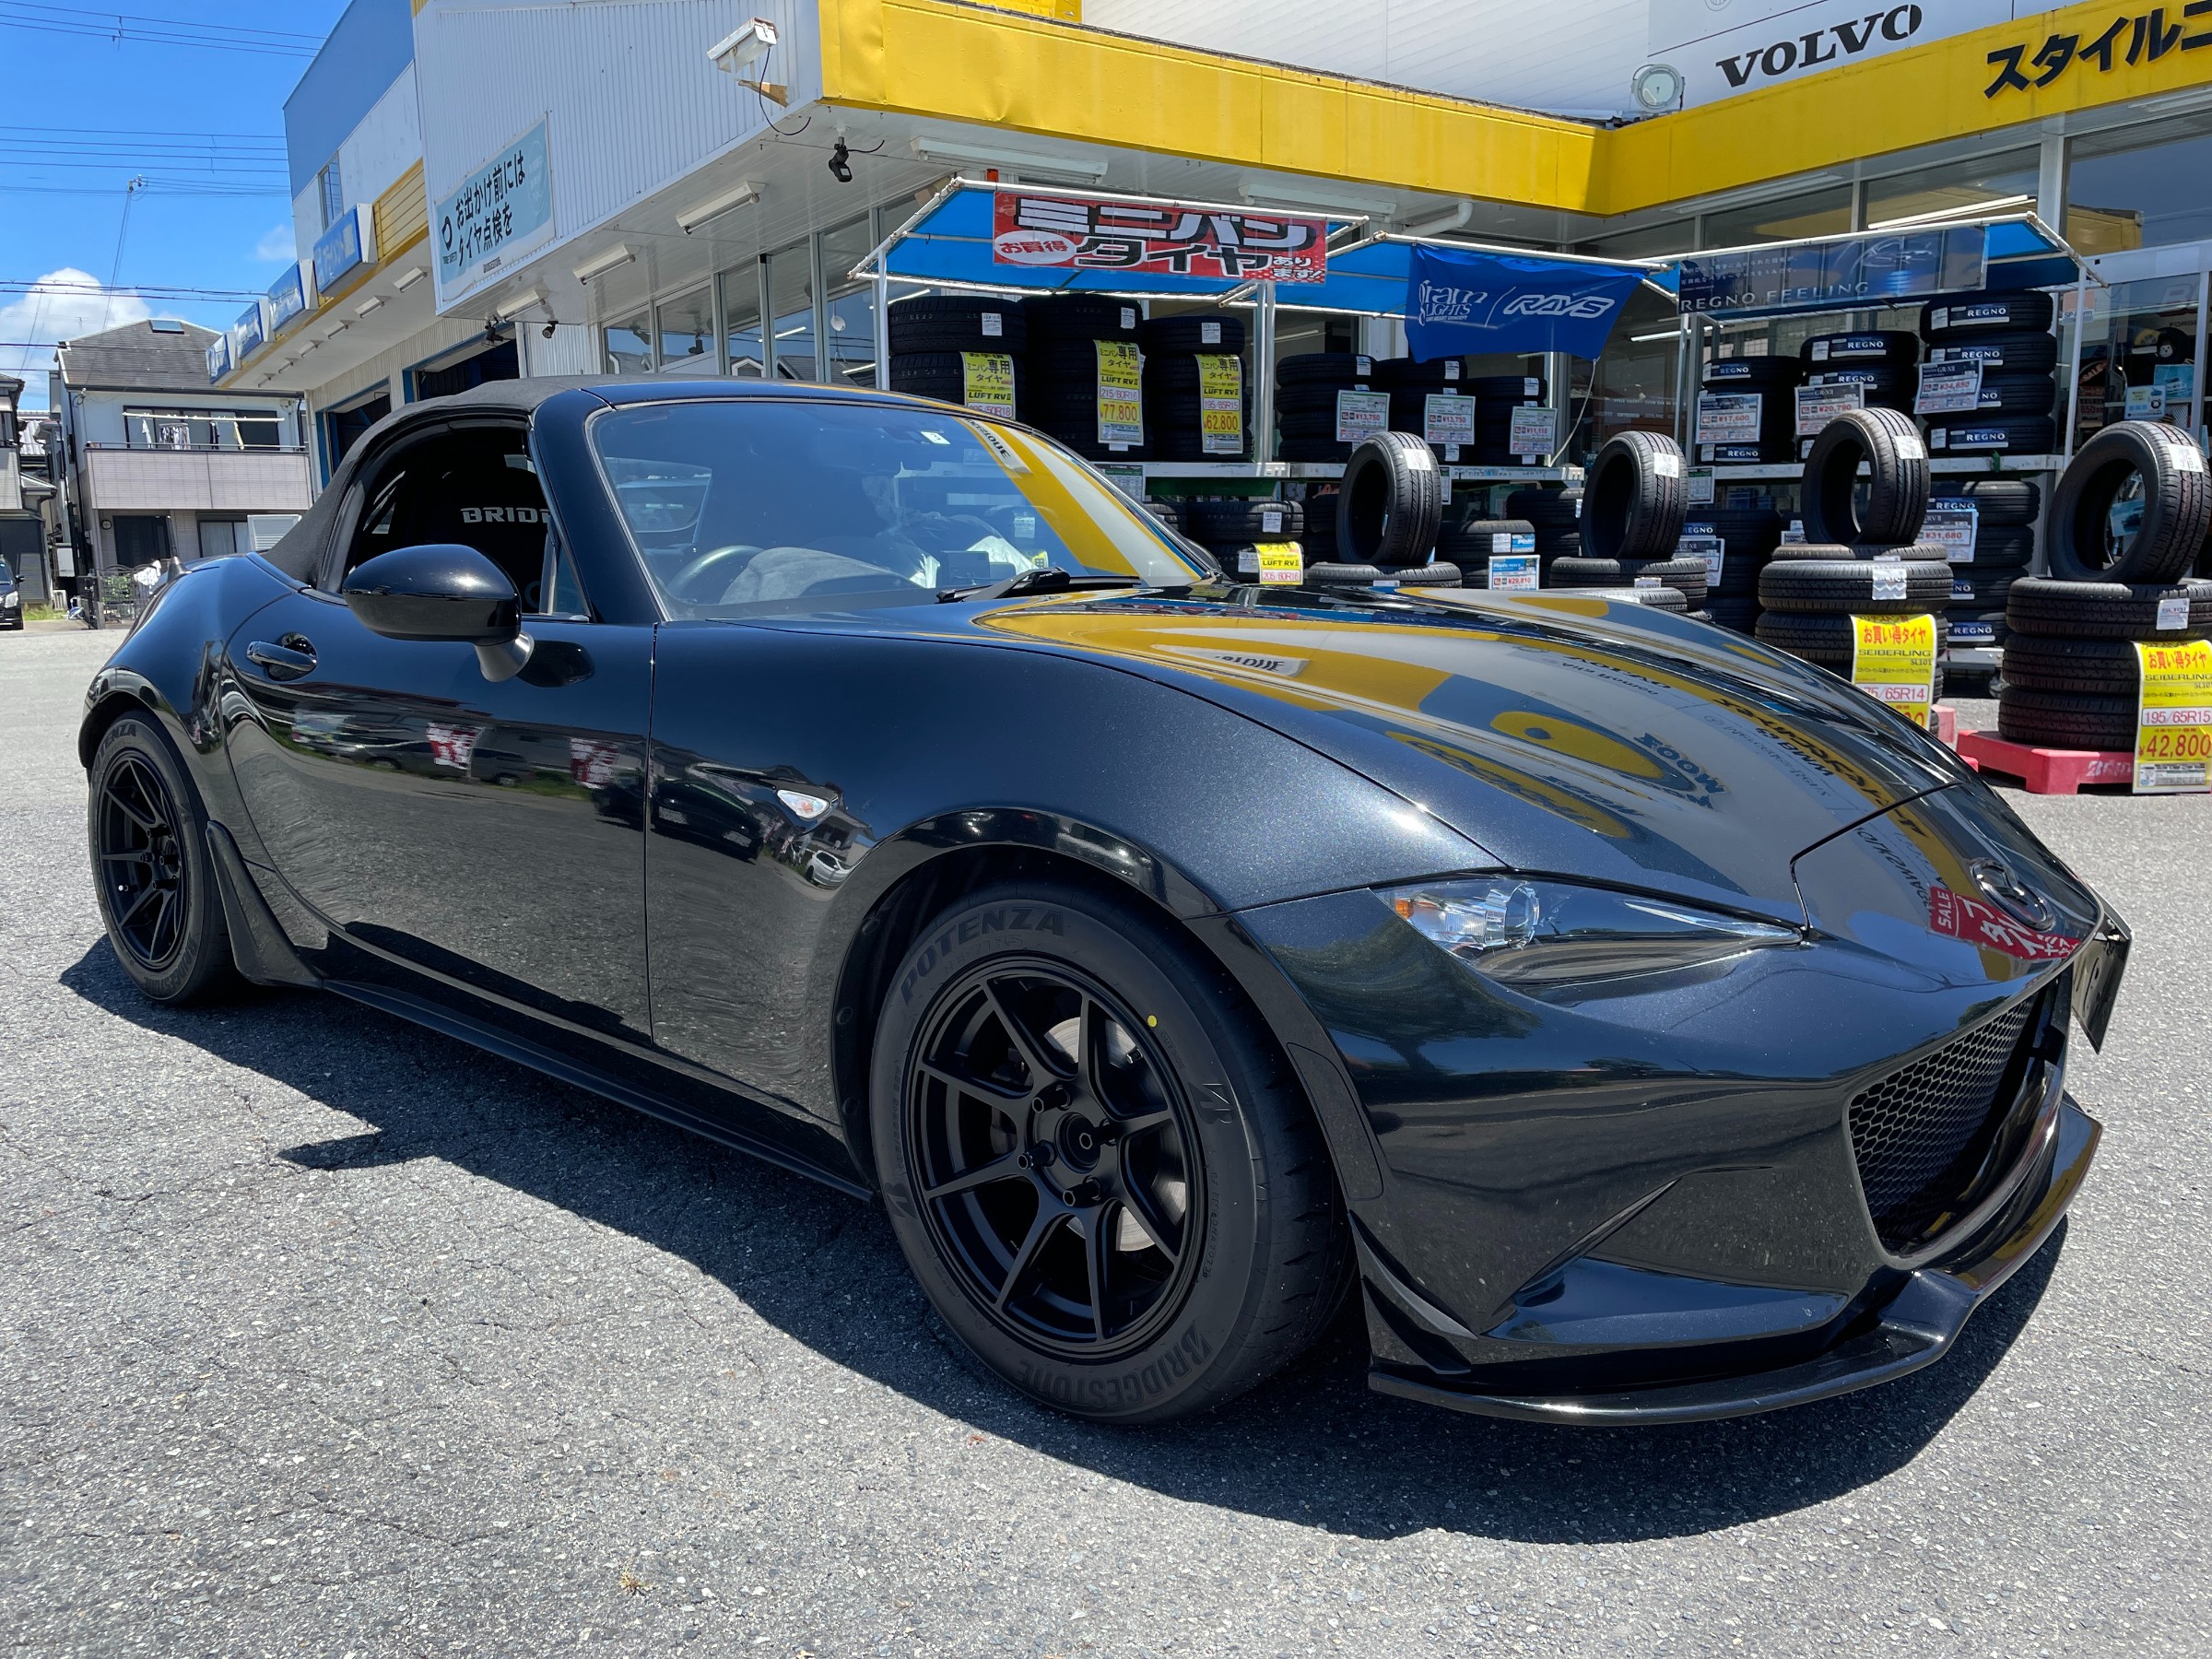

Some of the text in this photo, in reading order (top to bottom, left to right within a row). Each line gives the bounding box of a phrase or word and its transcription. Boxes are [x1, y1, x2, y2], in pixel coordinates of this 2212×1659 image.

[1715, 4, 1923, 88] VOLVO
[456, 150, 525, 229] お出かけ前には
[1016, 196, 1312, 250] ミニバン
[459, 202, 512, 266] タイヤ点検を
[998, 239, 1069, 254] お買得
[1074, 235, 1273, 277] タイヤ
[1273, 255, 1312, 267] あり
[1680, 281, 1869, 312] REGNO FEELING
[1503, 294, 1616, 319] RAYS
[1967, 307, 2006, 317] REGNO
[1847, 340, 1884, 348] REGNO
[1961, 350, 2000, 359] REGNO
[1108, 359, 1131, 368] タイヤ
[976, 374, 1003, 382] タイヤ
[1209, 371, 1232, 380] タイヤ
[1838, 374, 1875, 382] REGNO
[1966, 432, 2006, 441] REGNO
[1936, 501, 1975, 510] REGNO
[1925, 532, 1962, 540] ¥31,680
[1864, 626, 1926, 644] お買い得タイヤ
[1954, 626, 1993, 634] REGNO
[2148, 651, 2206, 669] お買い得タイヤ
[1864, 687, 1925, 700] 75/65R14
[2145, 710, 2211, 724] 195/65R15
[2138, 733, 2211, 758] ¥42,800
[1937, 889, 1952, 930] SALE
[900, 906, 1065, 1006] POTENZA
[1013, 1319, 1215, 1409] BRIDGESTONE
